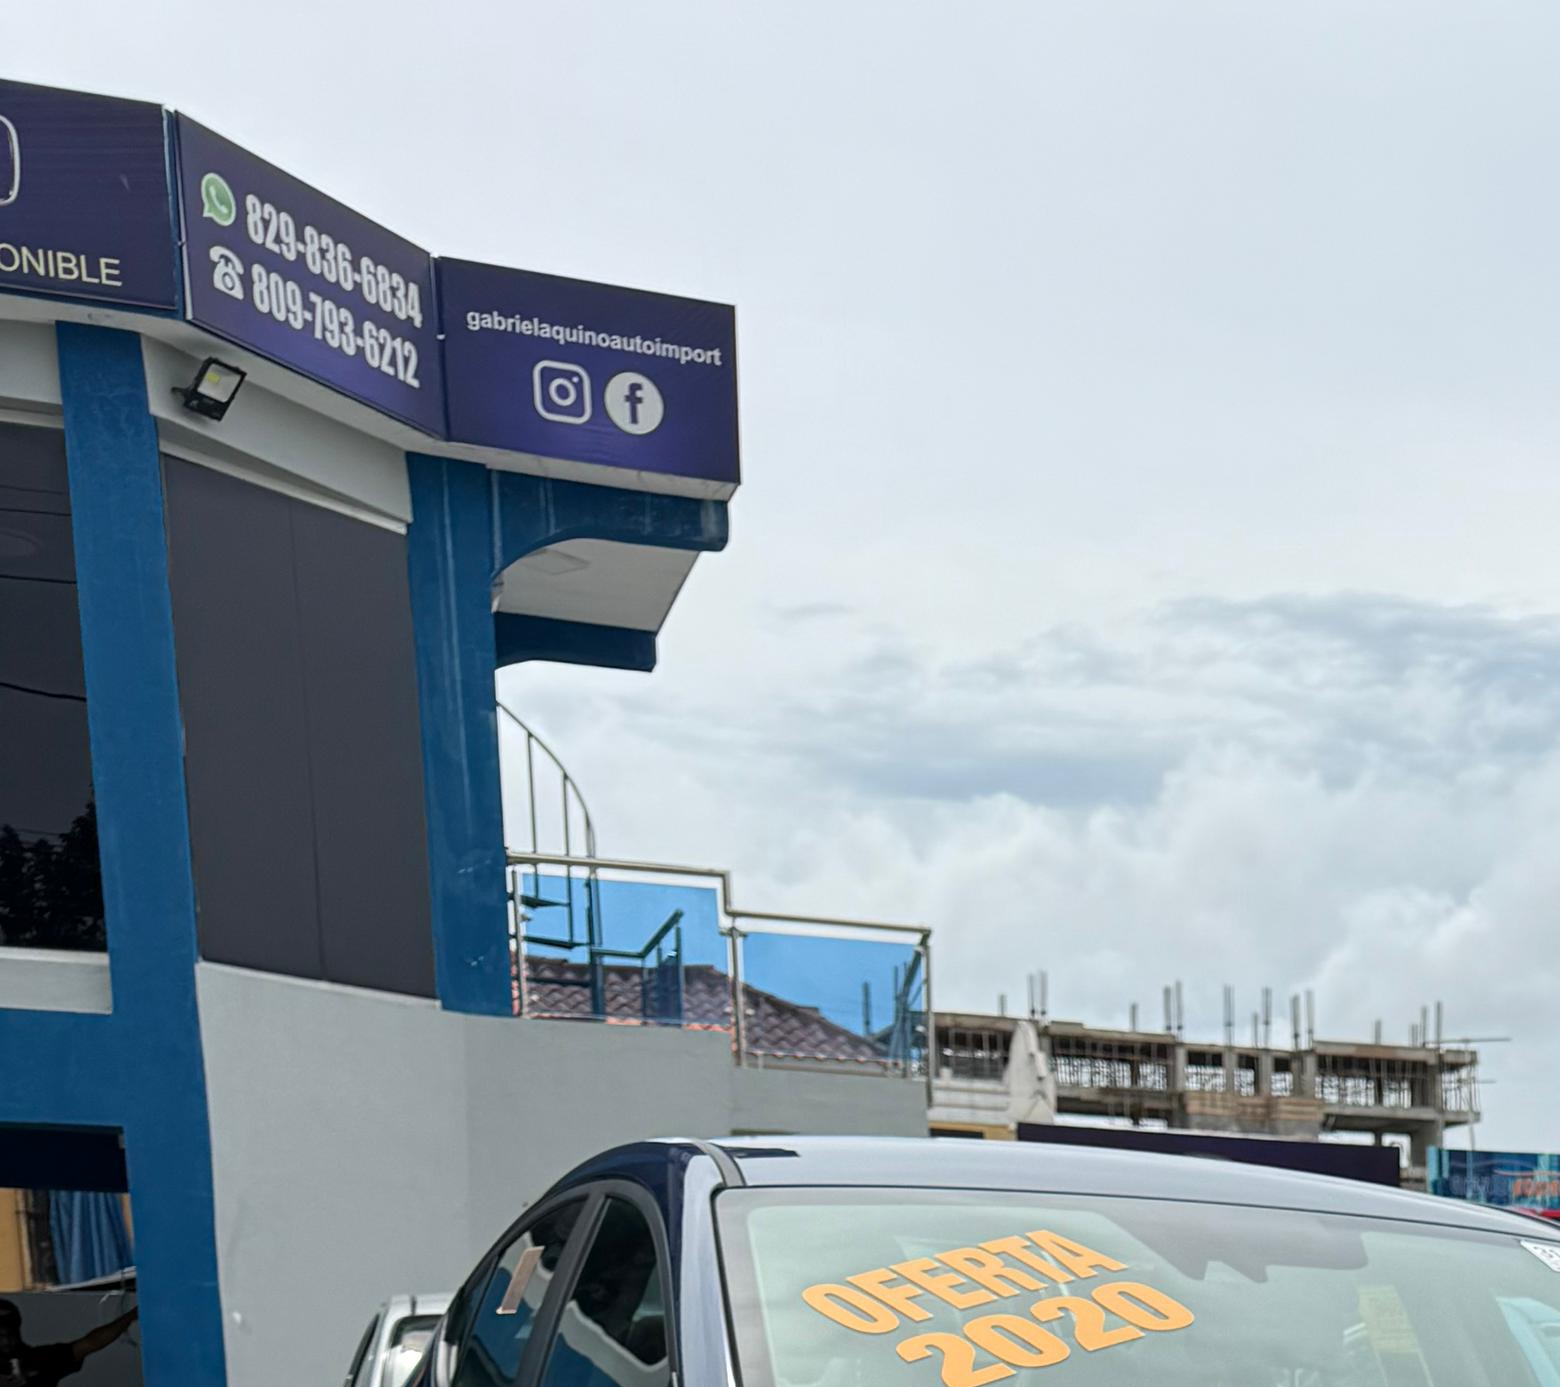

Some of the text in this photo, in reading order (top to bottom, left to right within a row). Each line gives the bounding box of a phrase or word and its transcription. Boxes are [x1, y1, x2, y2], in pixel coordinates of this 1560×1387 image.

[0, 243, 123, 286] ONIBLE
[246, 194, 422, 329] 829-836-6834
[252, 263, 420, 388] 809-793-6212
[466, 311, 722, 366] gabrielaquinoautoimport
[801, 1229, 1129, 1334] OFERTA
